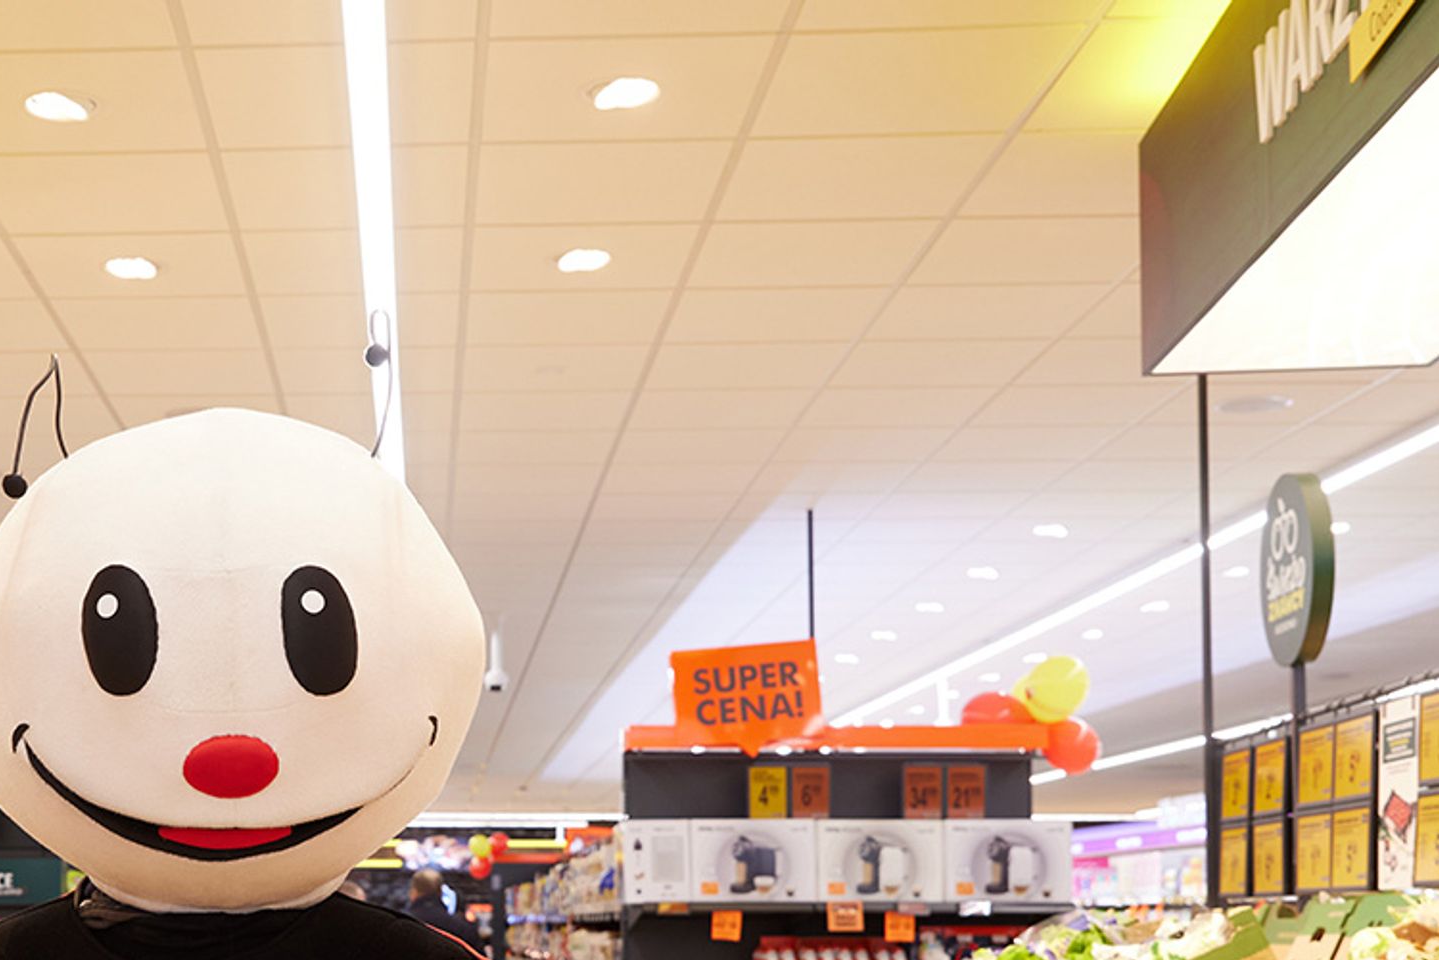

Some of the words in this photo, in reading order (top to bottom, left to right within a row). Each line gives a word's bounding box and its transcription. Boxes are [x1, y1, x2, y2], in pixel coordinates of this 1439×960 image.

[692, 660, 799, 695] SUPER
[696, 691, 804, 726] CENA!
[758, 785, 768, 806] 4
